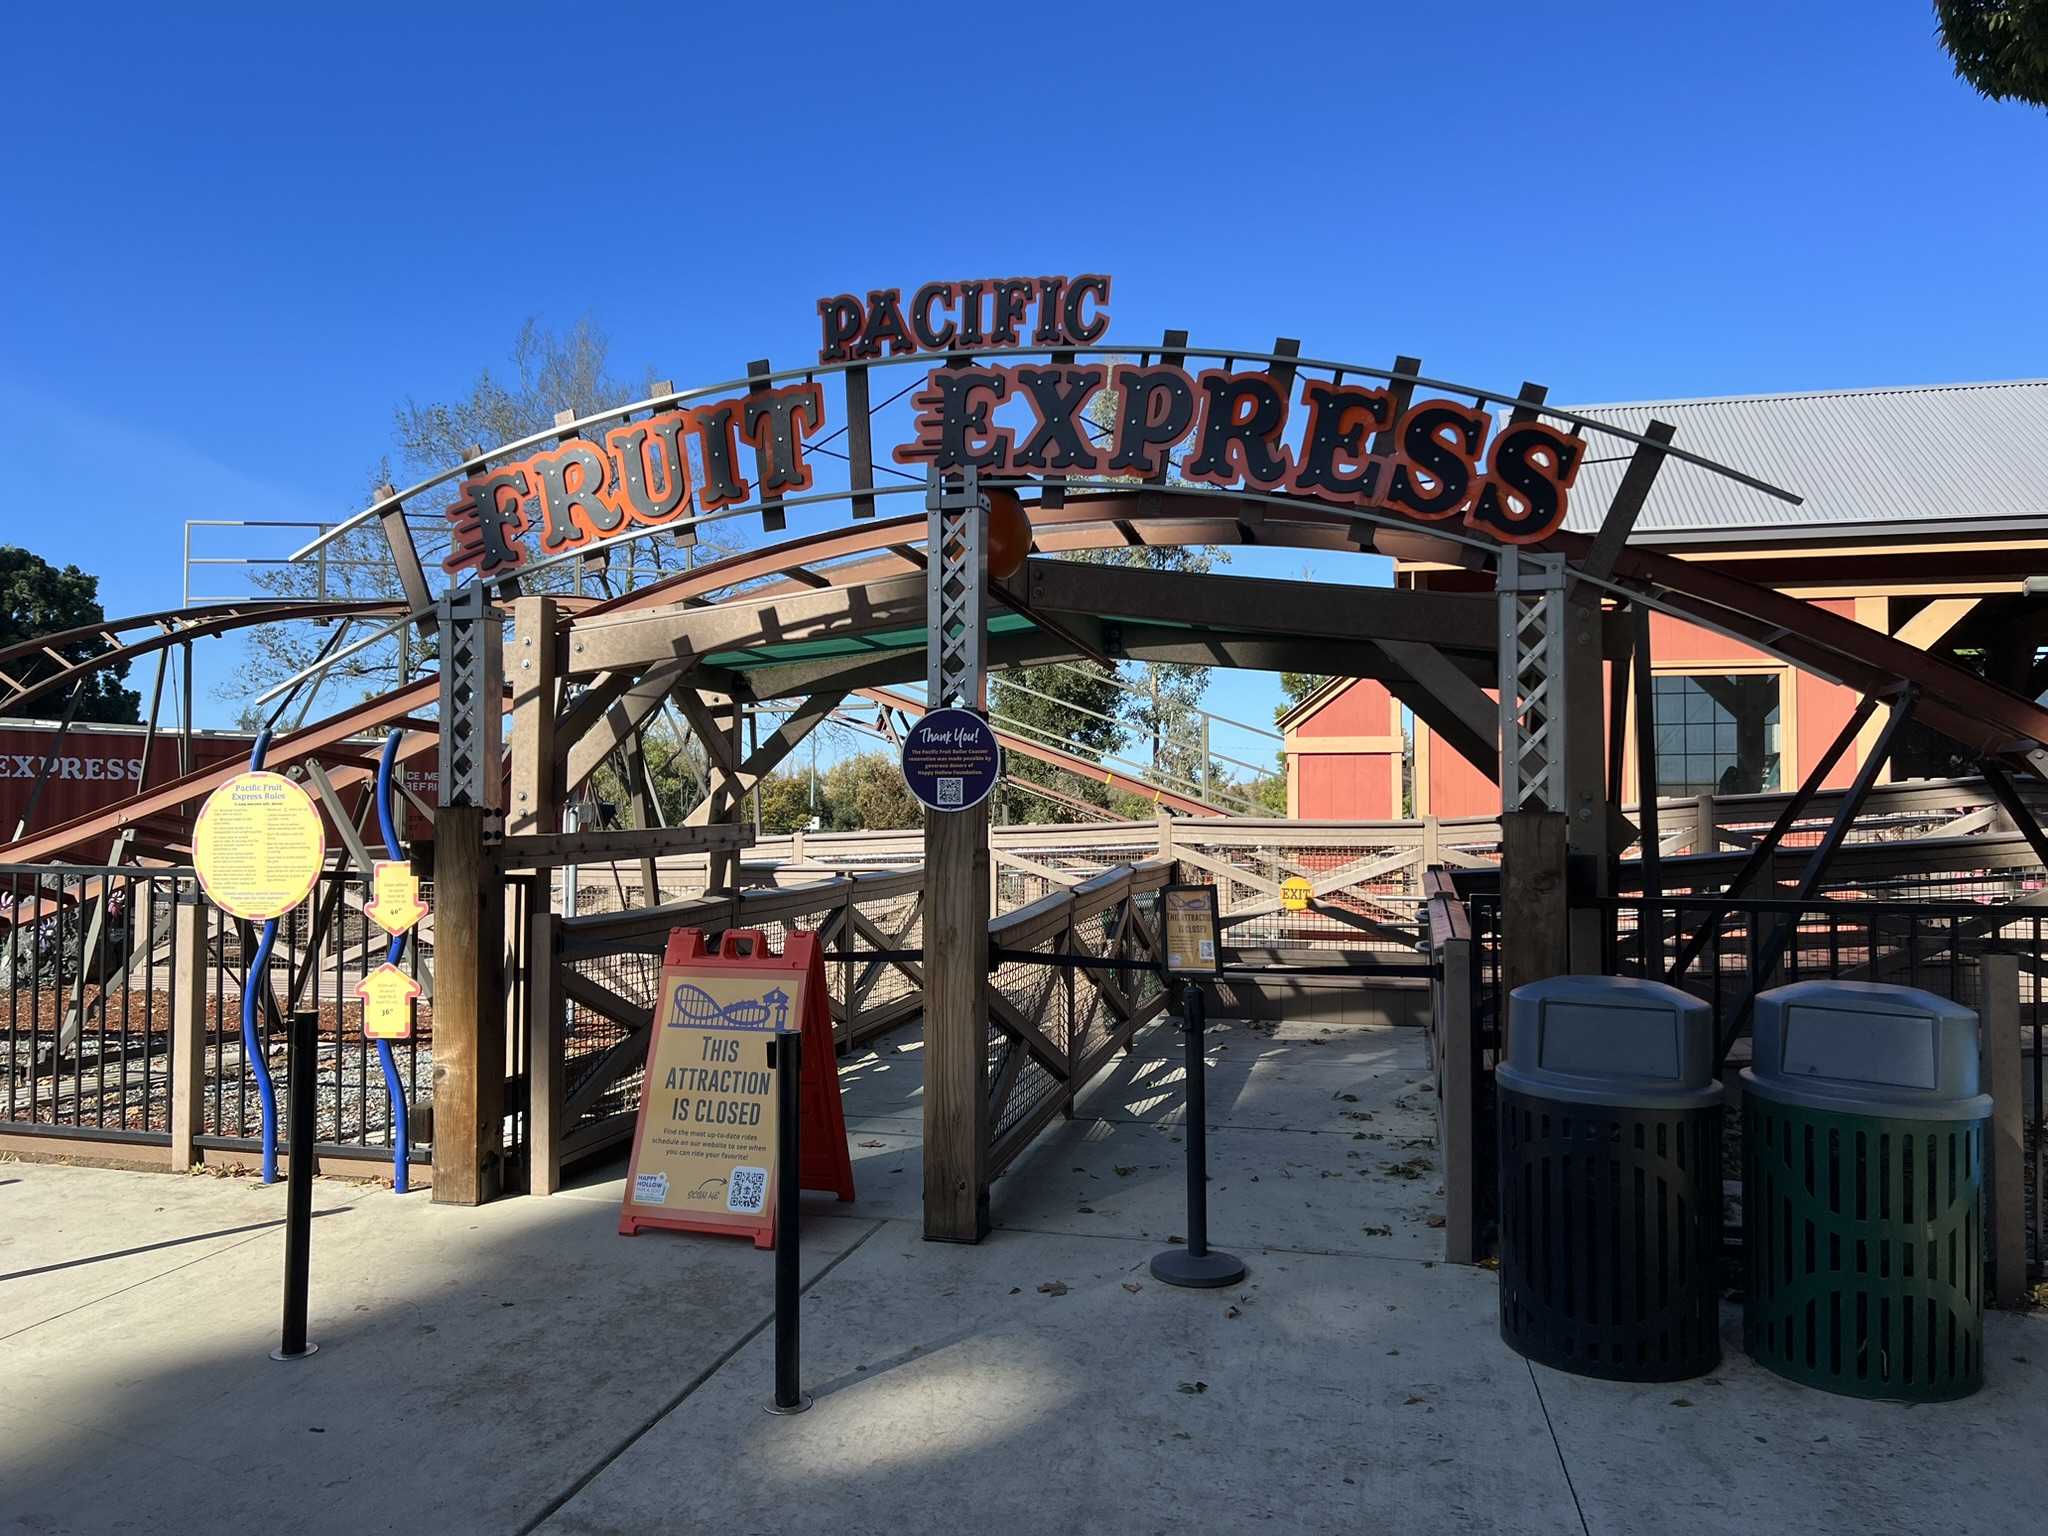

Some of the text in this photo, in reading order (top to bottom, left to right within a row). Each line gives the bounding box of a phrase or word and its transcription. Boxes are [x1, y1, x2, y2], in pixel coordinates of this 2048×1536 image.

[818, 275, 1110, 363] PACIFIC
[461, 364, 1587, 575] FRUIT EXPRESS
[919, 727, 979, 748] Thank You!
[236, 784, 262, 792] Pacific
[232, 792, 286, 801] Express Rules
[1281, 887, 1311, 900] EXIT
[1167, 913, 1212, 922] THIS ATTRACTIO
[1178, 925, 1207, 934] IS CLOSED
[702, 1036, 739, 1063] THIS
[665, 1067, 771, 1095] ATTRACTION
[672, 1098, 761, 1126] IS CLOSED
[678, 1128, 689, 1136] the
[707, 1131, 741, 1140] up-to-date
[741, 1133, 758, 1141] rides
[651, 1137, 679, 1146] schedule
[702, 1141, 727, 1149] website
[748, 1144, 766, 1152] when
[721, 1152, 748, 1161] favorite!
[638, 1174, 658, 1182] HAPPY
[636, 1181, 663, 1189] HOLLOW
[687, 1190, 720, 1201] SCAN ME
